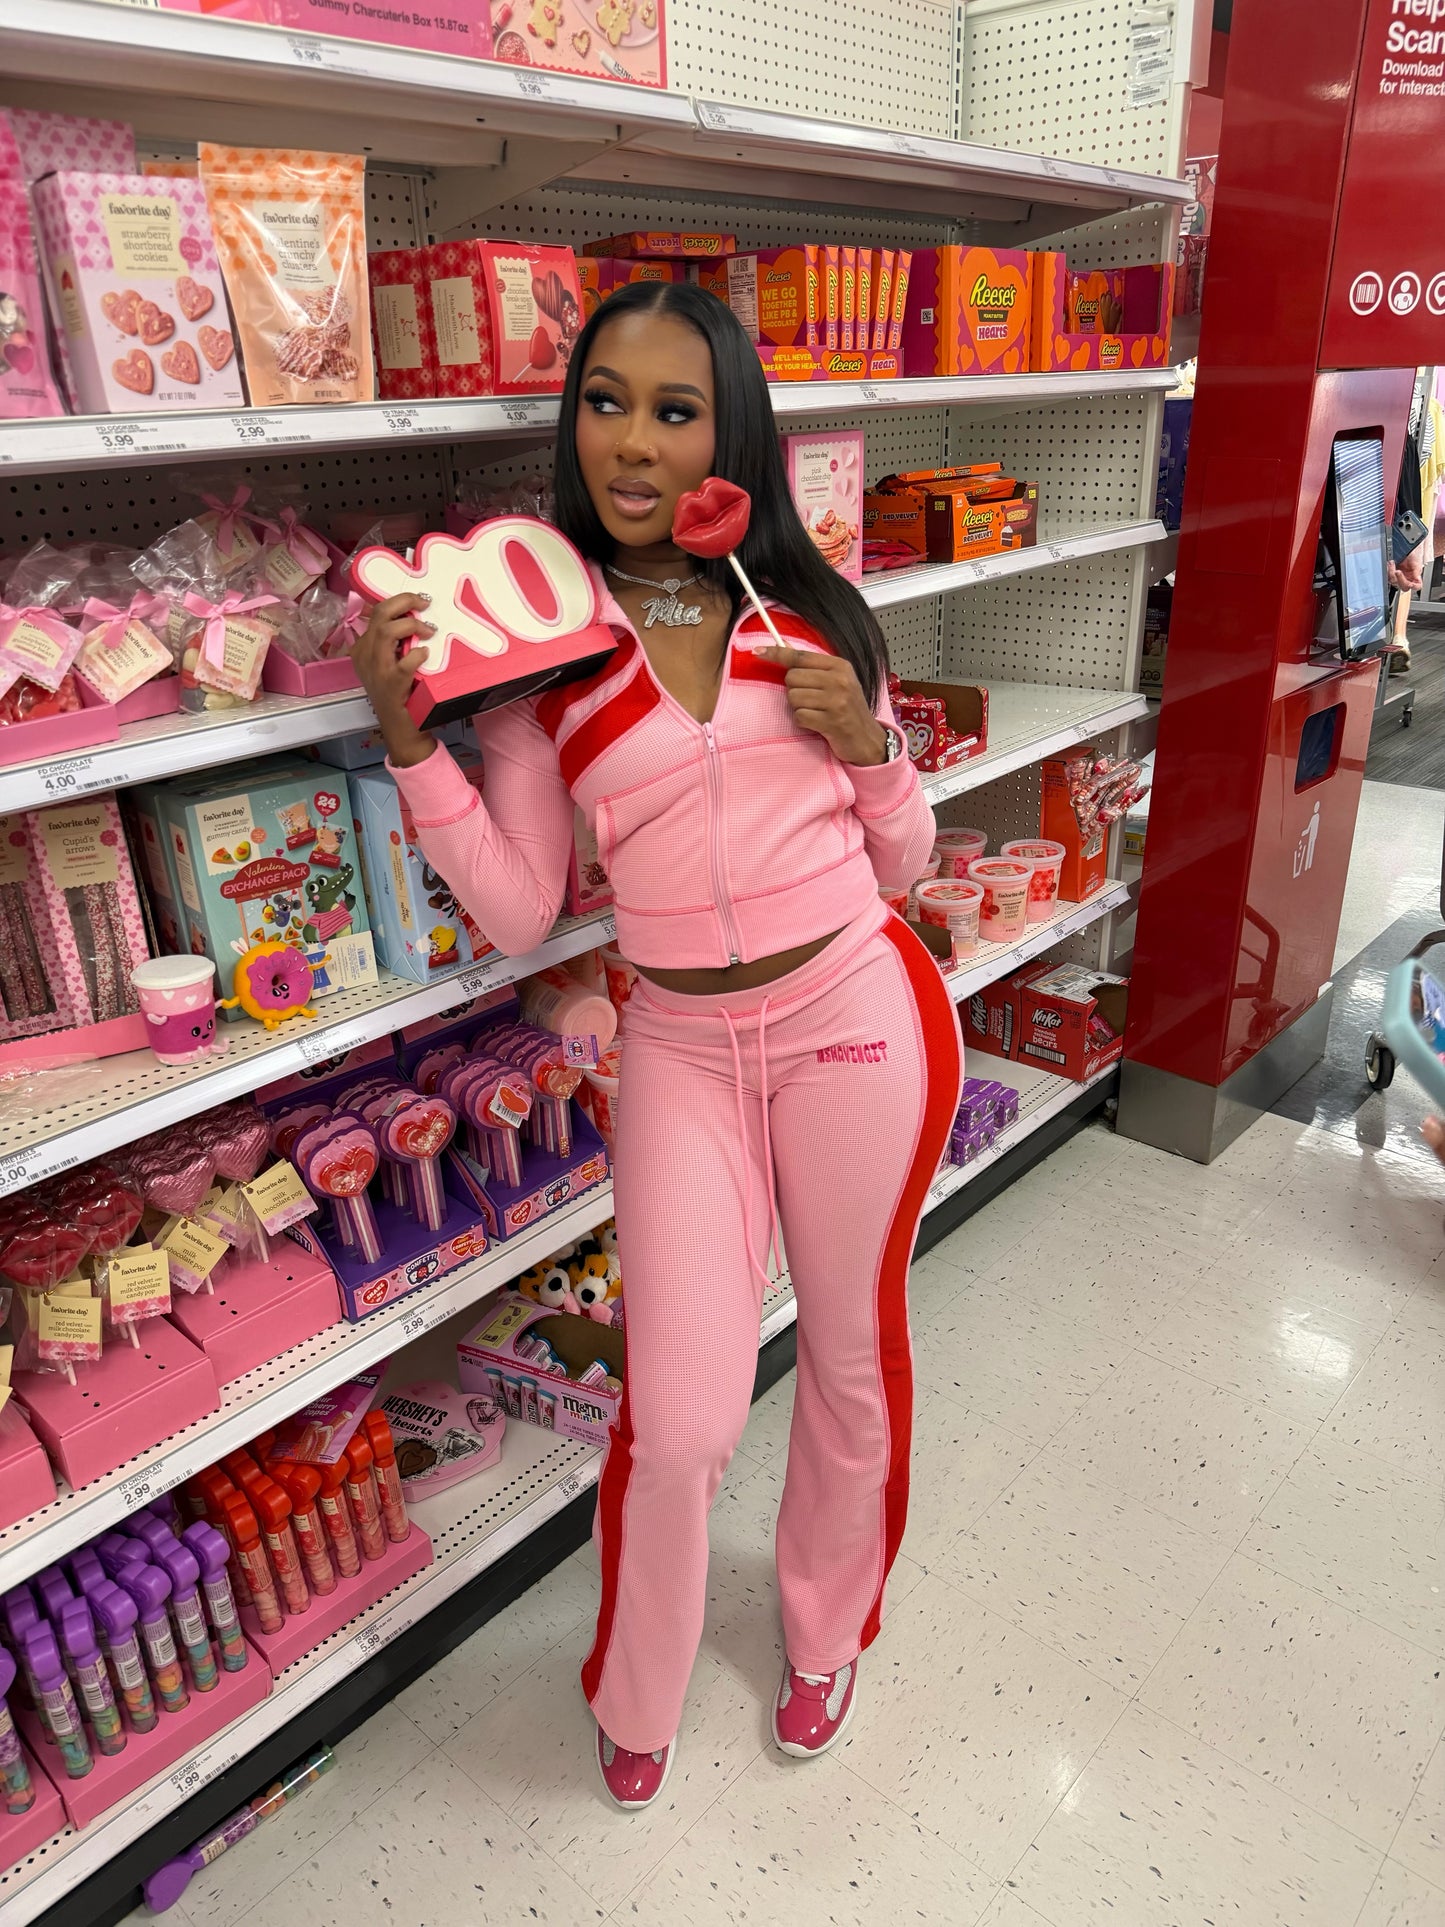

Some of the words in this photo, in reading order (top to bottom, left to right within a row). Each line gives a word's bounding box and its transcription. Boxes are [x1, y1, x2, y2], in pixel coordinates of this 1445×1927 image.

[308, 0, 350, 15] Gummy
[353, 3, 410, 24] Charcuterie
[413, 13, 432, 27] Box
[1382, 58, 1445, 77] Download
[1379, 77, 1398, 94] for
[108, 203, 151, 217] favorite
[152, 204, 171, 220] day
[263, 212, 300, 225] favorite
[302, 214, 320, 227] day
[121, 229, 171, 241] strawberry
[651, 237, 680, 247] Heart
[123, 240, 173, 251] shortbread
[683, 237, 720, 254] Reese's
[133, 252, 169, 262] cookies
[765, 271, 792, 283] Reese's
[1073, 276, 1078, 287] 6
[762, 289, 778, 300] WE
[781, 287, 797, 299] GO
[970, 273, 1017, 307] Reese's
[762, 300, 797, 310] TOGETHER
[1075, 293, 1099, 314] Reese's
[762, 311, 779, 320] LIKE
[781, 310, 790, 318] PB
[791, 309, 798, 318] &
[977, 325, 1008, 340] Hearts
[1101, 340, 1120, 356] Reese's
[772, 354, 790, 362] WE'LL
[792, 353, 812, 361] NEVER
[828, 353, 863, 373] Reese's
[871, 358, 895, 370] Heart
[387, 418, 412, 428] 3.99
[507, 411, 527, 421] 4.00
[237, 426, 265, 438] 2.99
[102, 434, 134, 447] 3.99
[962, 508, 993, 527] Reese's
[963, 534, 974, 544] RED
[974, 531, 993, 542] VELVET
[352, 515, 600, 677] XO
[641, 597, 703, 628] Mia
[49, 758, 94, 772] CHOCOLATE
[45, 775, 76, 790] 4.00
[318, 795, 337, 809] 24
[203, 811, 230, 822] favorite
[231, 807, 245, 818] day
[48, 818, 83, 831] favorite
[84, 816, 100, 827] day
[62, 836, 95, 847] Cupid's
[206, 832, 230, 842] gummy
[231, 827, 250, 837] candy
[65, 845, 96, 855] arrows
[244, 864, 286, 879] Valentine
[223, 874, 280, 894] EXCHANGE
[282, 866, 308, 881] PACK
[463, 979, 482, 992] 5.99
[971, 994, 986, 1035] KitKat
[1032, 1009, 1062, 1028] KitKat
[1033, 1035, 1057, 1048] bears
[256, 1180, 277, 1195] favorite
[278, 1175, 289, 1186] day
[545, 1176, 570, 1196] CONFETTI
[262, 1199, 290, 1215] chocolate
[290, 1189, 303, 1201] pop
[272, 1190, 285, 1202] milk
[182, 1231, 203, 1247] favorite
[203, 1243, 215, 1253] day
[165, 1246, 194, 1267] chocolate
[193, 1262, 206, 1273] pop
[182, 1248, 196, 1259] milk
[121, 1267, 142, 1276] favorite
[142, 1263, 157, 1272] day
[407, 1252, 438, 1273] CONFETTI
[409, 1261, 438, 1283] POP
[120, 1287, 132, 1295] milk
[132, 1282, 161, 1292] chocolate
[126, 1292, 141, 1300] candy
[51, 1306, 76, 1315] favorite
[77, 1308, 88, 1316] day
[60, 1326, 90, 1334] chocolate
[404, 1317, 424, 1334] 2.99
[54, 1332, 71, 1340] candy
[383, 1395, 449, 1427] HERSHEY'S
[562, 1396, 608, 1421] m&m's
[391, 1416, 434, 1438] hearts
[129, 1462, 164, 1485] CHOCOLATE
[124, 1483, 150, 1505] 2.99
[562, 1481, 579, 1497] 5.99
[360, 1633, 381, 1652] 5.99
[179, 1760, 198, 1776] CANDY
[176, 1771, 200, 1792] 1.99
